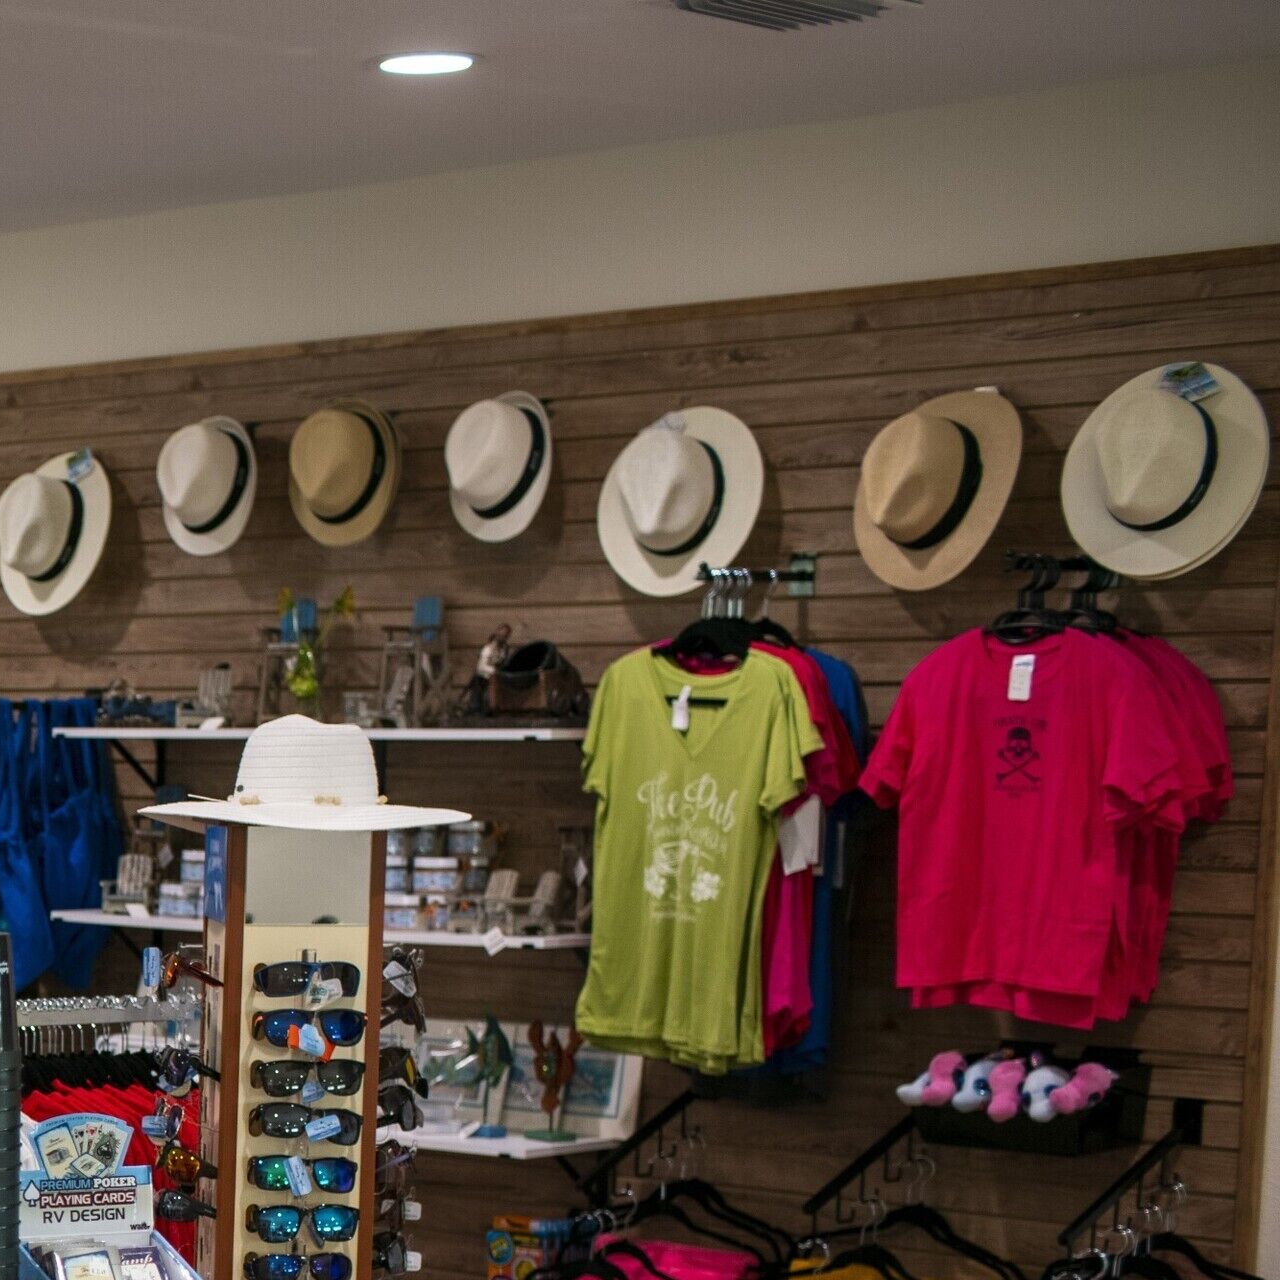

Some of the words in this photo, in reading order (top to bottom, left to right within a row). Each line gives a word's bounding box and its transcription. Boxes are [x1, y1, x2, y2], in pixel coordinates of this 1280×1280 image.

[684, 773, 739, 832] Pub
[40, 1178, 90, 1191] PREMIUM
[93, 1176, 136, 1188] POKER
[41, 1193, 91, 1207] PLAYING
[93, 1190, 136, 1204] CARDS
[42, 1208, 64, 1224] RV
[70, 1207, 126, 1223] DESIGN
